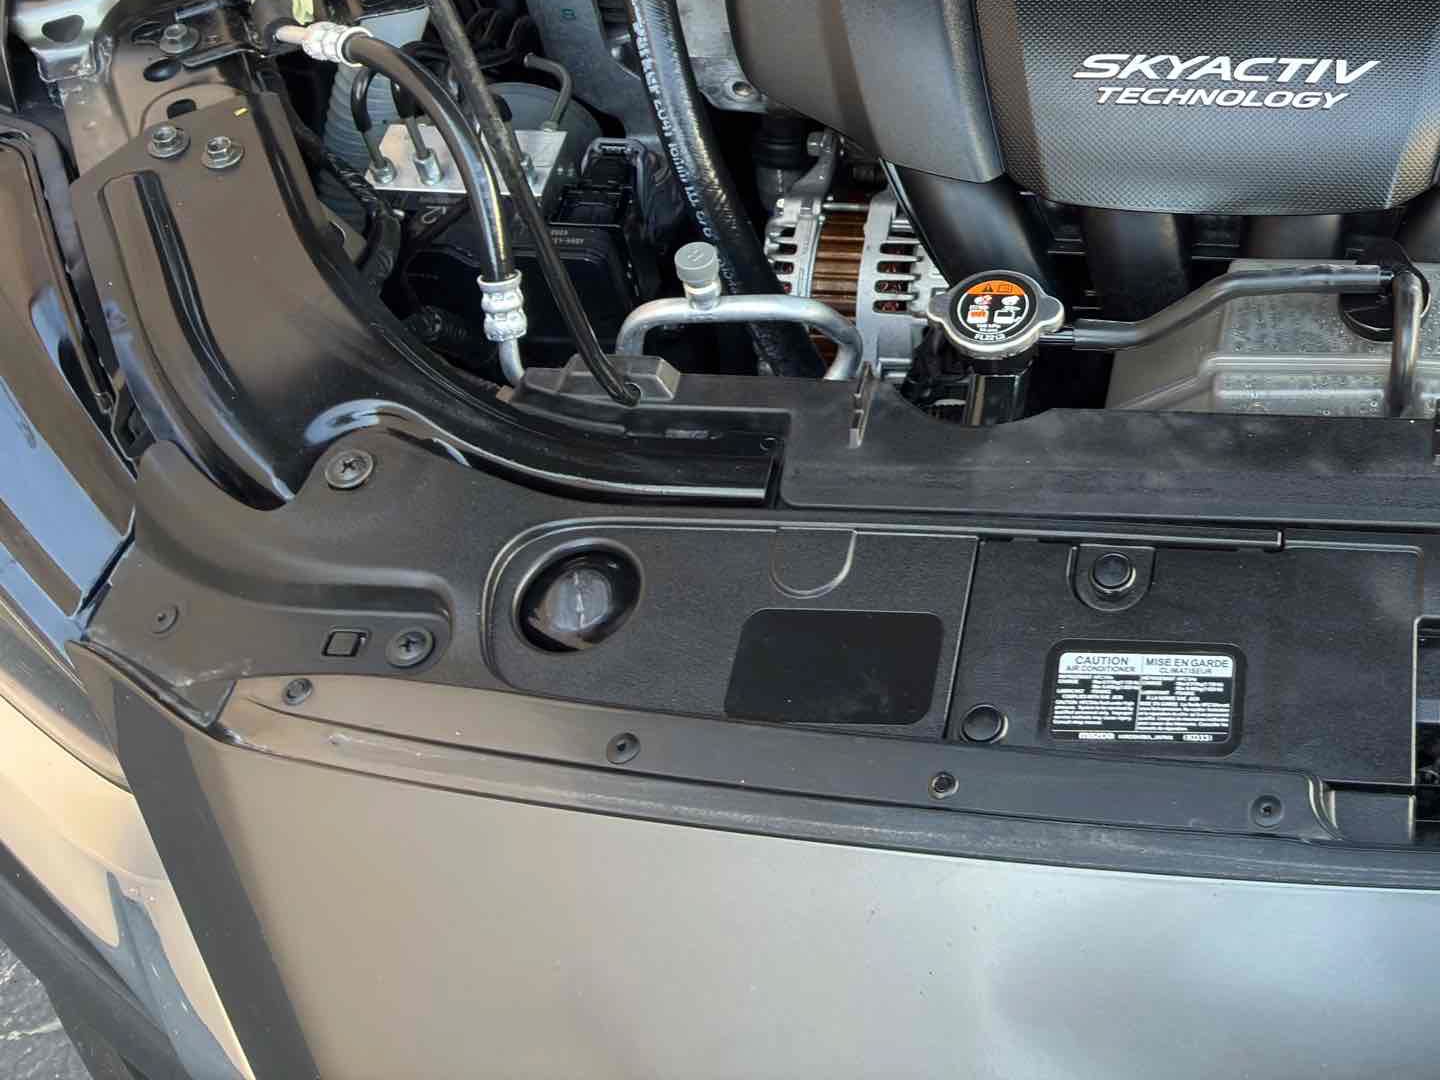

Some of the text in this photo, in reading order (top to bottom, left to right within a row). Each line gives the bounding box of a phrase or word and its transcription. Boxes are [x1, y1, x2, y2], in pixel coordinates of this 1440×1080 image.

[1072, 54, 1381, 85] SKYACTIV
[1097, 87, 1350, 110] TECHNOLOGY
[1075, 656, 1128, 665] CAUTION
[1146, 658, 1229, 668] MISE EN GARDE
